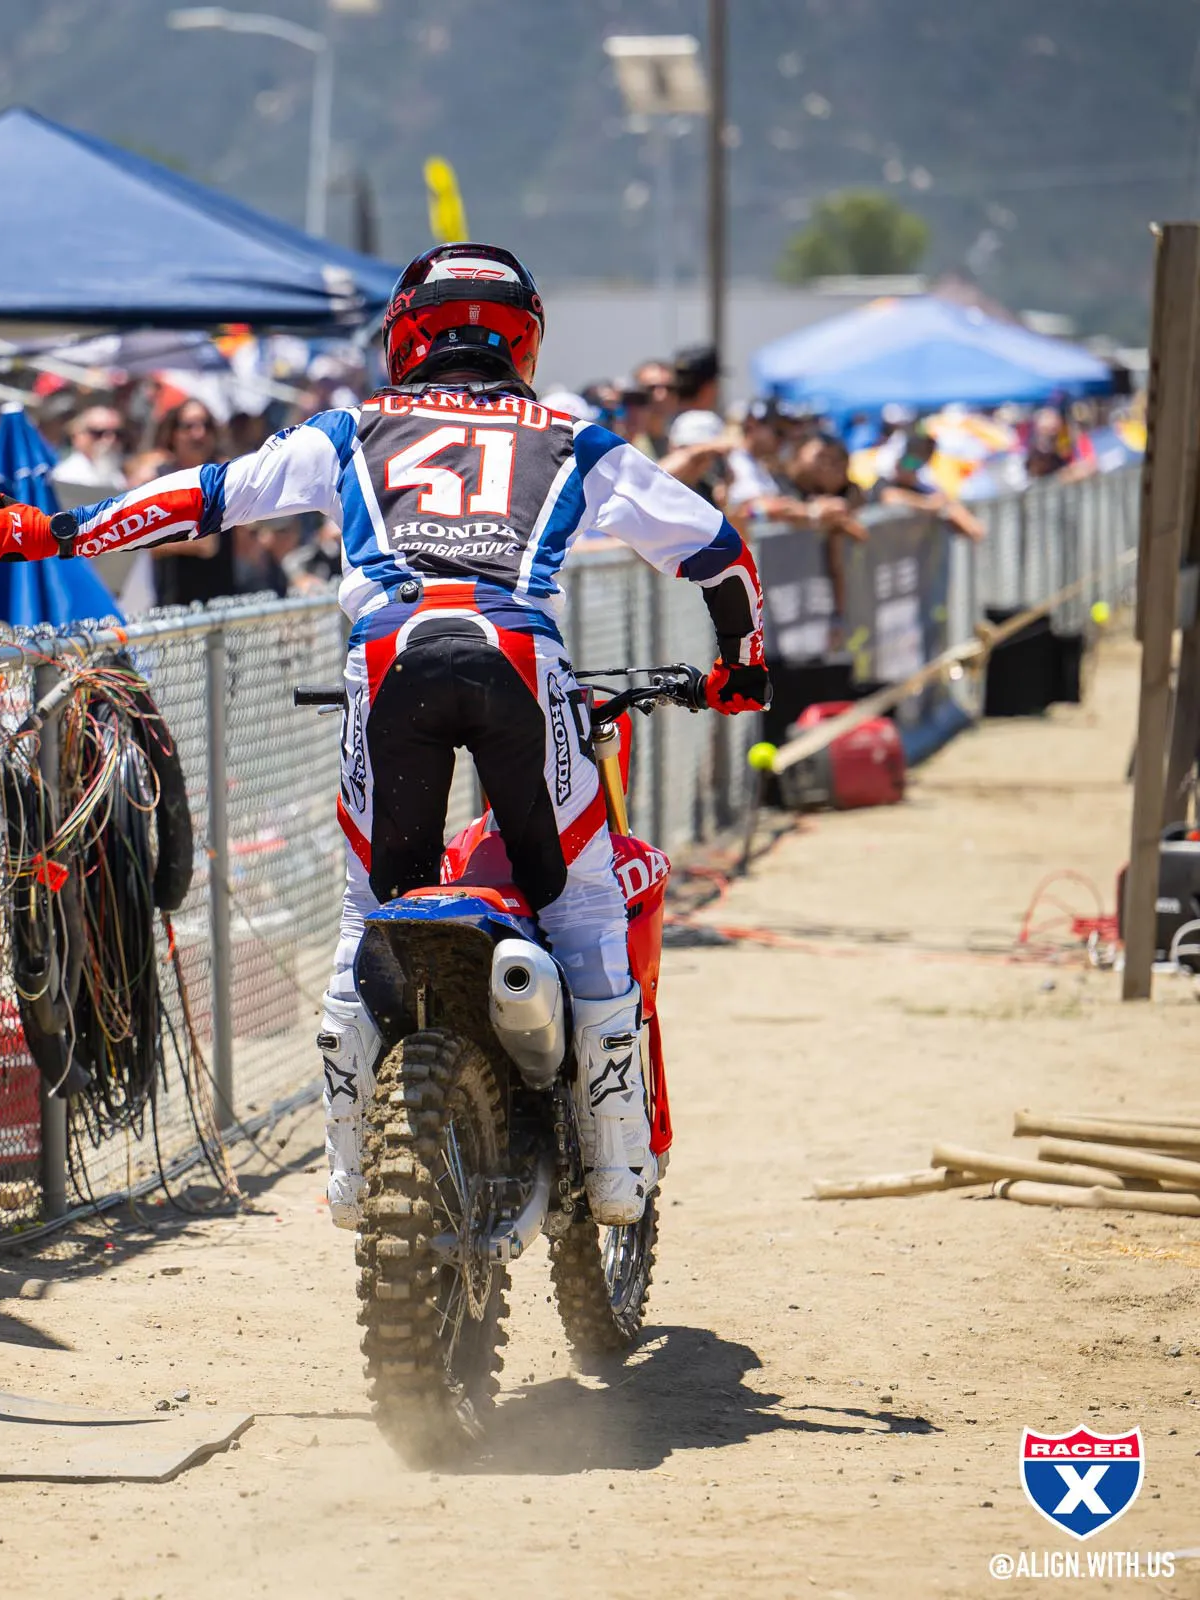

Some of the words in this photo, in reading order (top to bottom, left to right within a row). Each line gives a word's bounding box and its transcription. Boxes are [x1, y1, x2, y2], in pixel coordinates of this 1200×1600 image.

[383, 392, 550, 429] CANARD
[386, 426, 517, 517] 41
[8, 511, 23, 546] FLY
[391, 521, 520, 540] HONDA
[398, 541, 521, 558] PROGRESSIVE
[549, 702, 571, 805] HONDA
